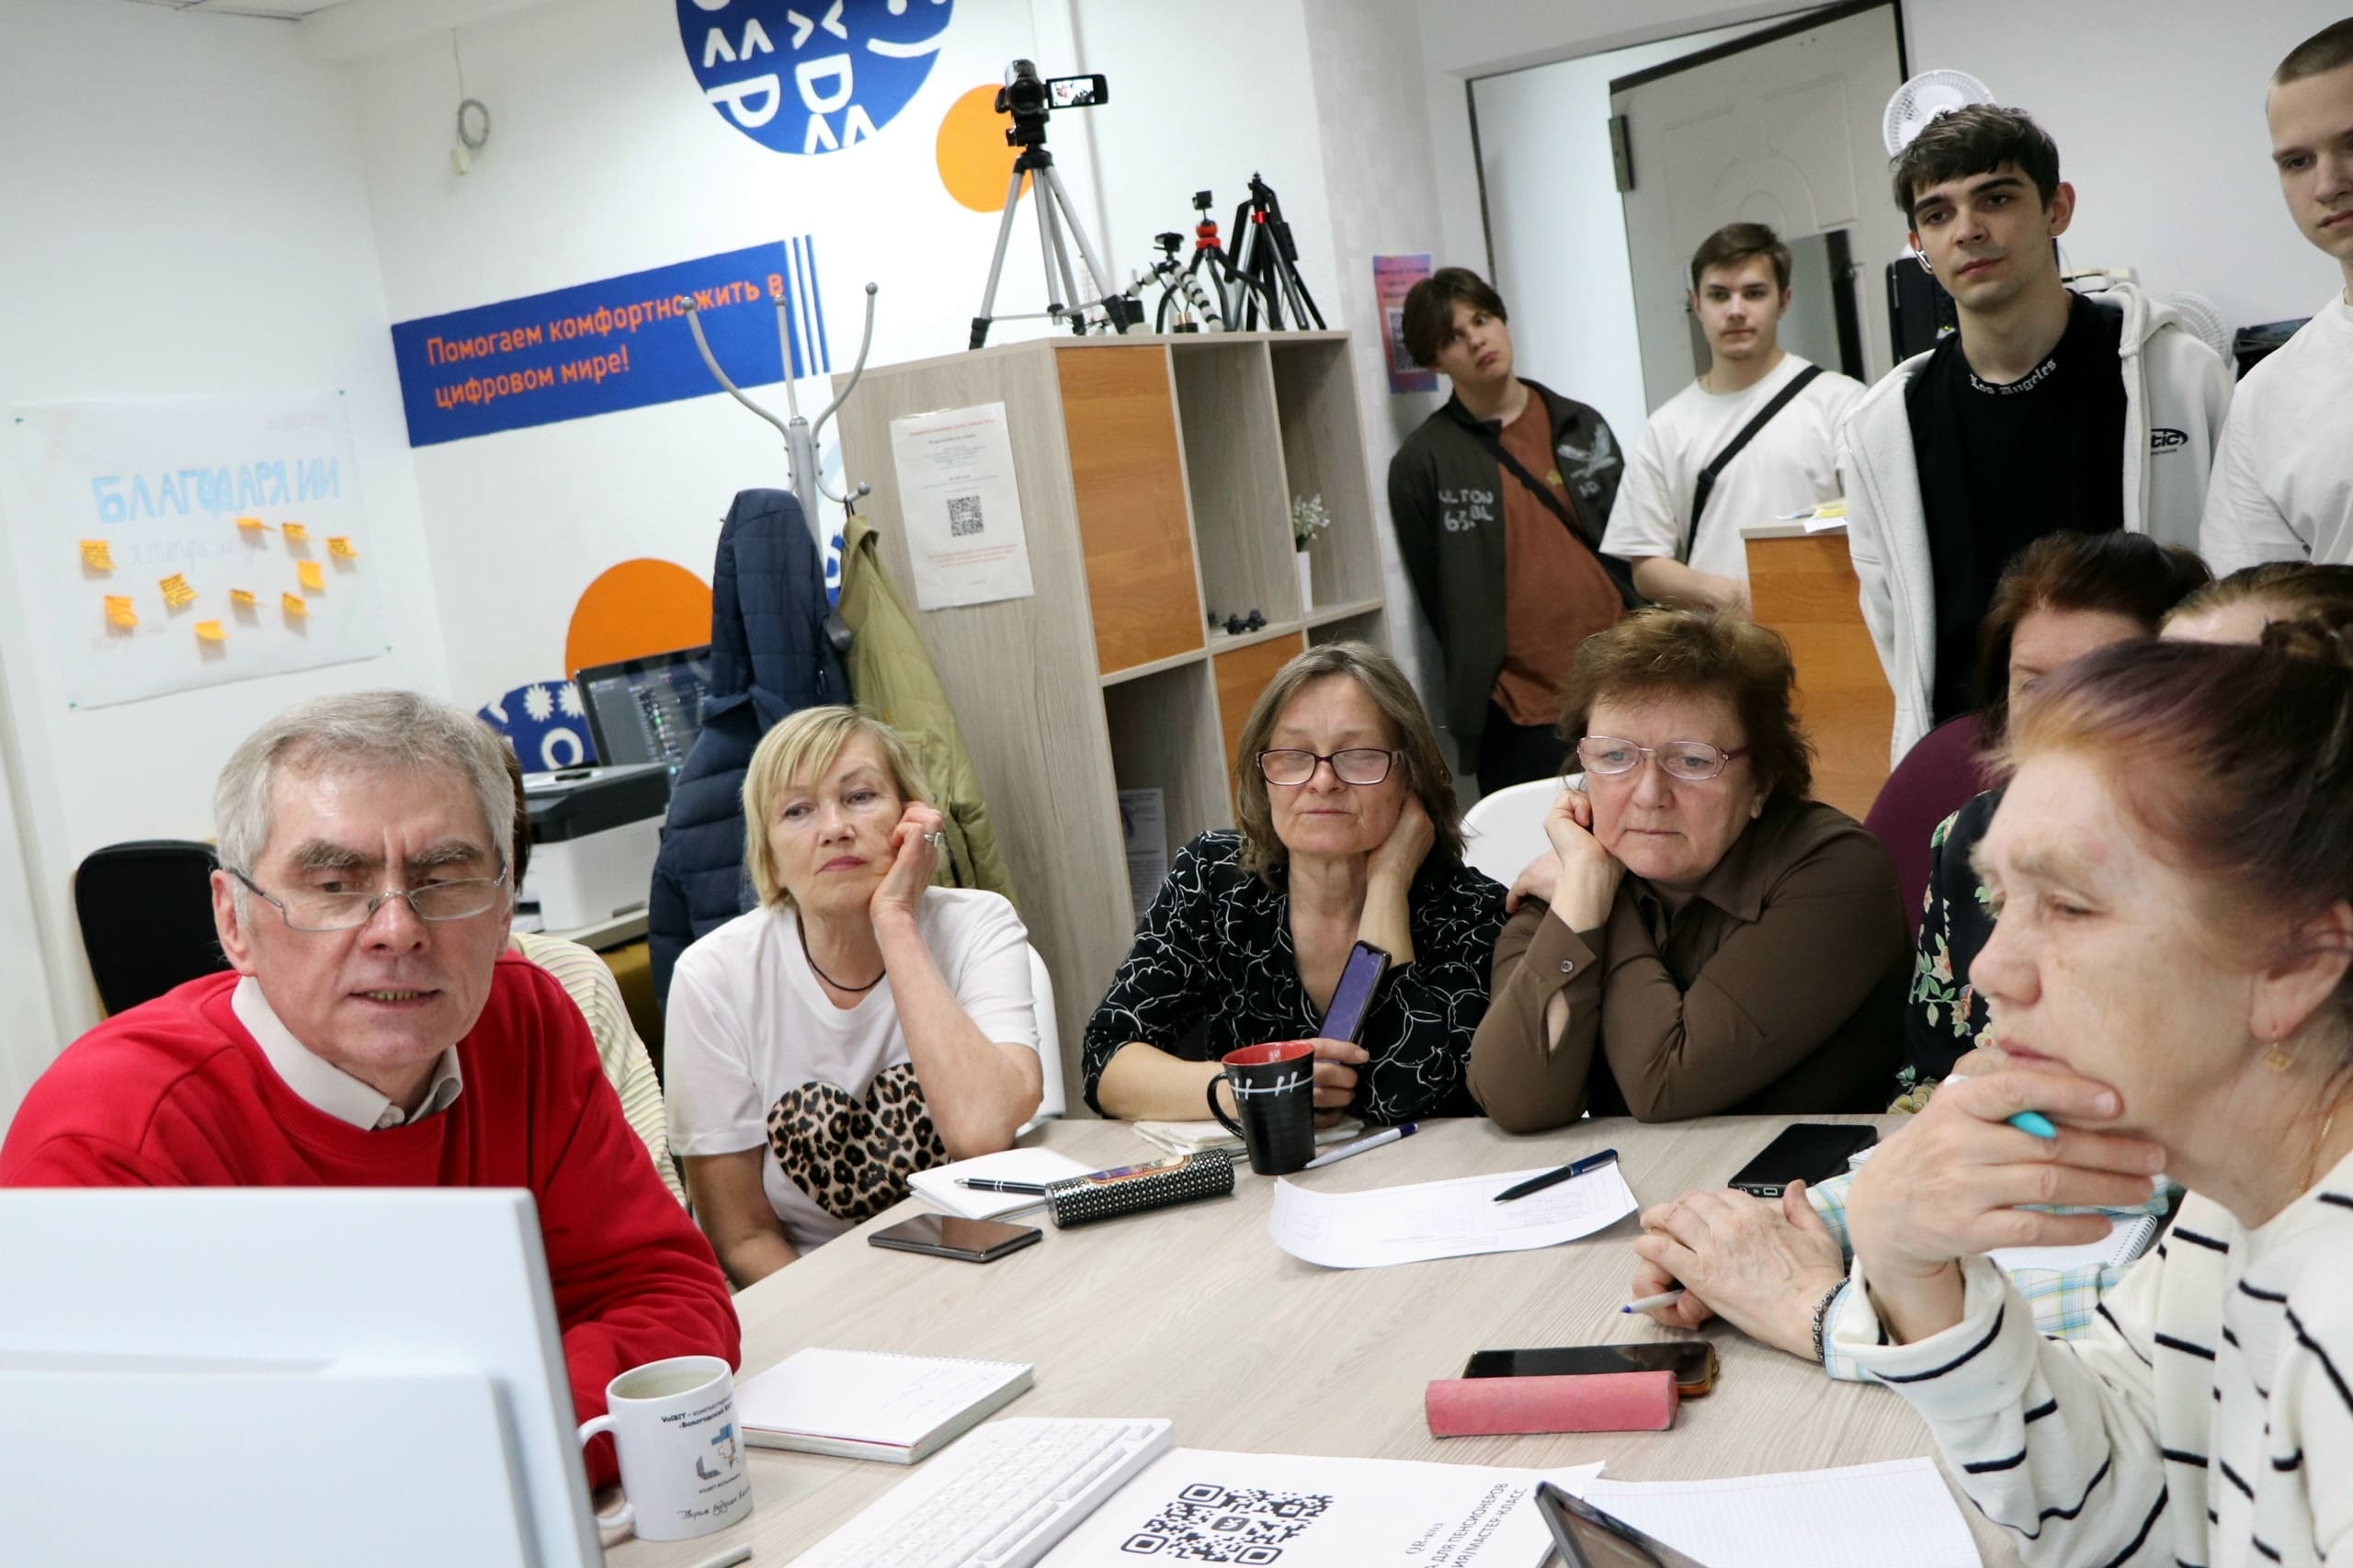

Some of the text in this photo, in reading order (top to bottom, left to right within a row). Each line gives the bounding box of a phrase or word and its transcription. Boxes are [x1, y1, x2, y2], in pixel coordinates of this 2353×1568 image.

[427, 326, 542, 365] Помогаем
[550, 294, 686, 342] комфортно
[693, 282, 761, 311] жить
[435, 346, 629, 409] цифровом мире!
[1969, 358, 2057, 395] Los Angeles
[91, 460, 290, 523] БЛАГОДАРЯ
[1431, 1483, 1508, 1563] ДЛЯ ПЕНСИОНЕРОВ
